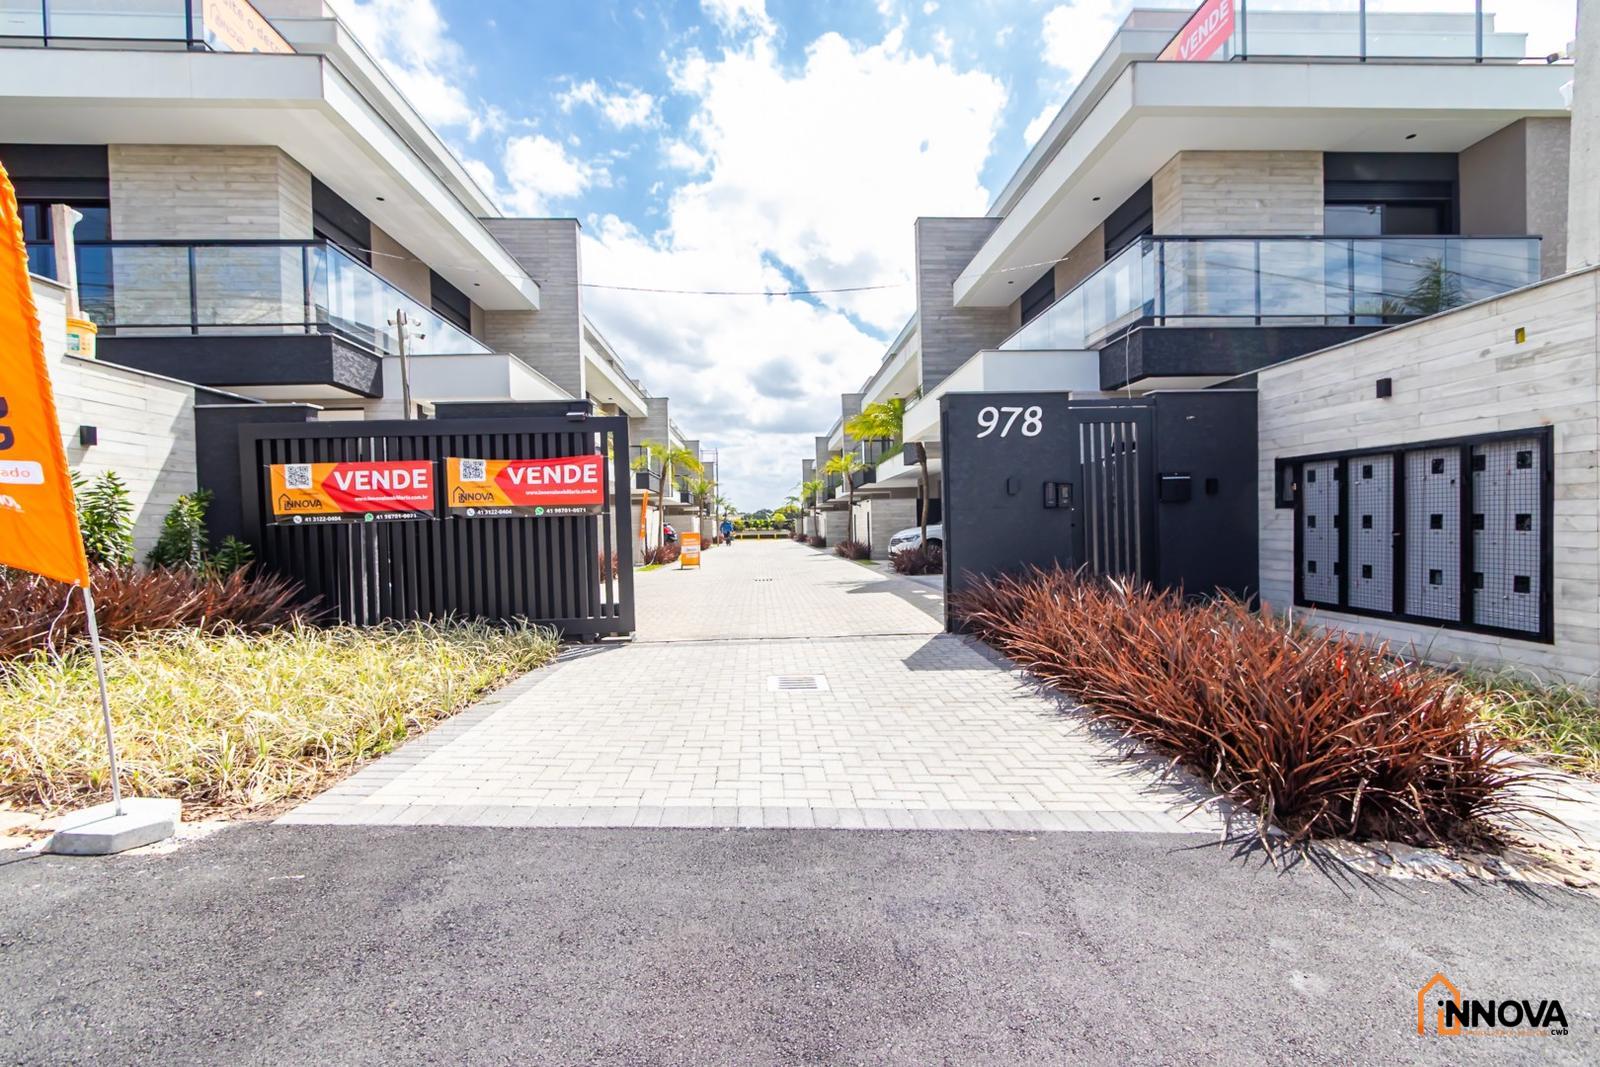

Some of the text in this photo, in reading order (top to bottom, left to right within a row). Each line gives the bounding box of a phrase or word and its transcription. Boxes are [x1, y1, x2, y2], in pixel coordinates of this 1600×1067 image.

[1180, 0, 1229, 60] VENDE
[976, 405, 1043, 438] 978
[1, 467, 31, 478] ado
[333, 468, 428, 491] VENDE
[507, 463, 598, 485] VENDE
